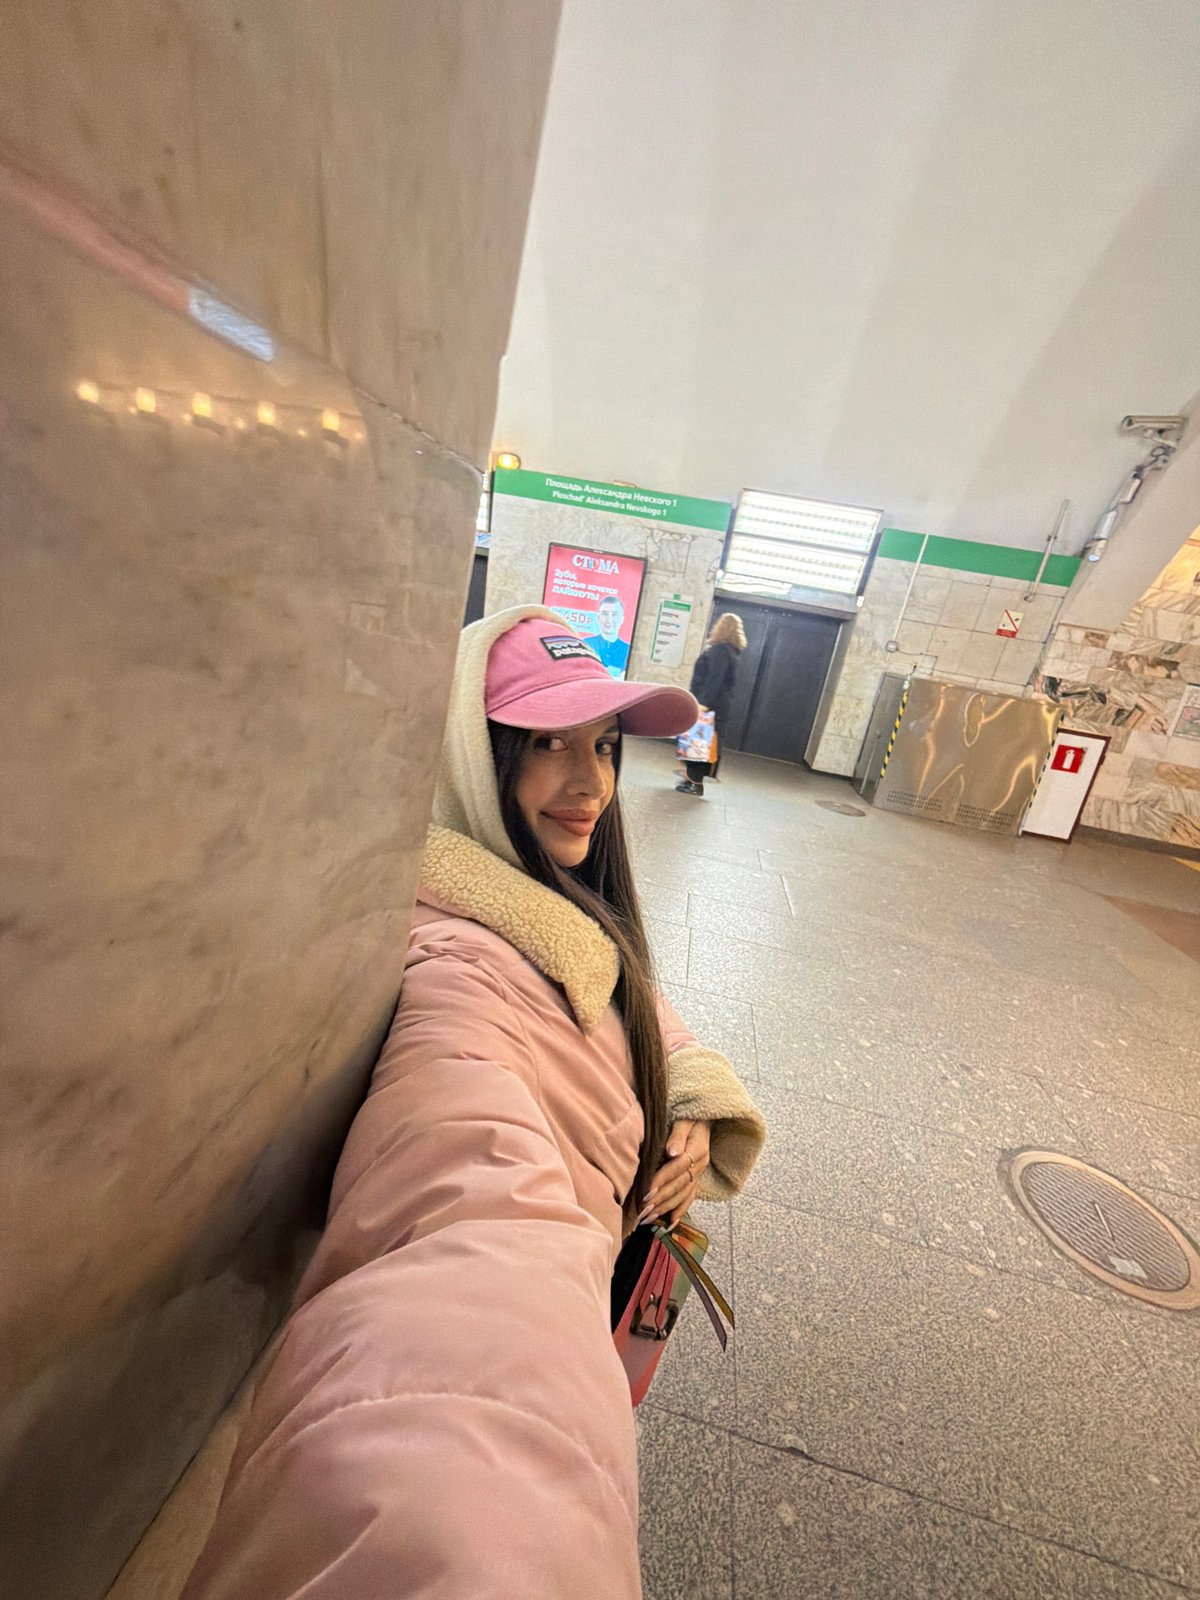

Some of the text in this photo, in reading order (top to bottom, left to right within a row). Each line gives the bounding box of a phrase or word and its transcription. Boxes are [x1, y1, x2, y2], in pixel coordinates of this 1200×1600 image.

[545, 478, 583, 492] Площадь
[584, 485, 632, 500] Александра
[633, 493, 671, 506] Невского
[585, 496, 625, 509] Aleksandra
[626, 503, 662, 516] Nevskogo
